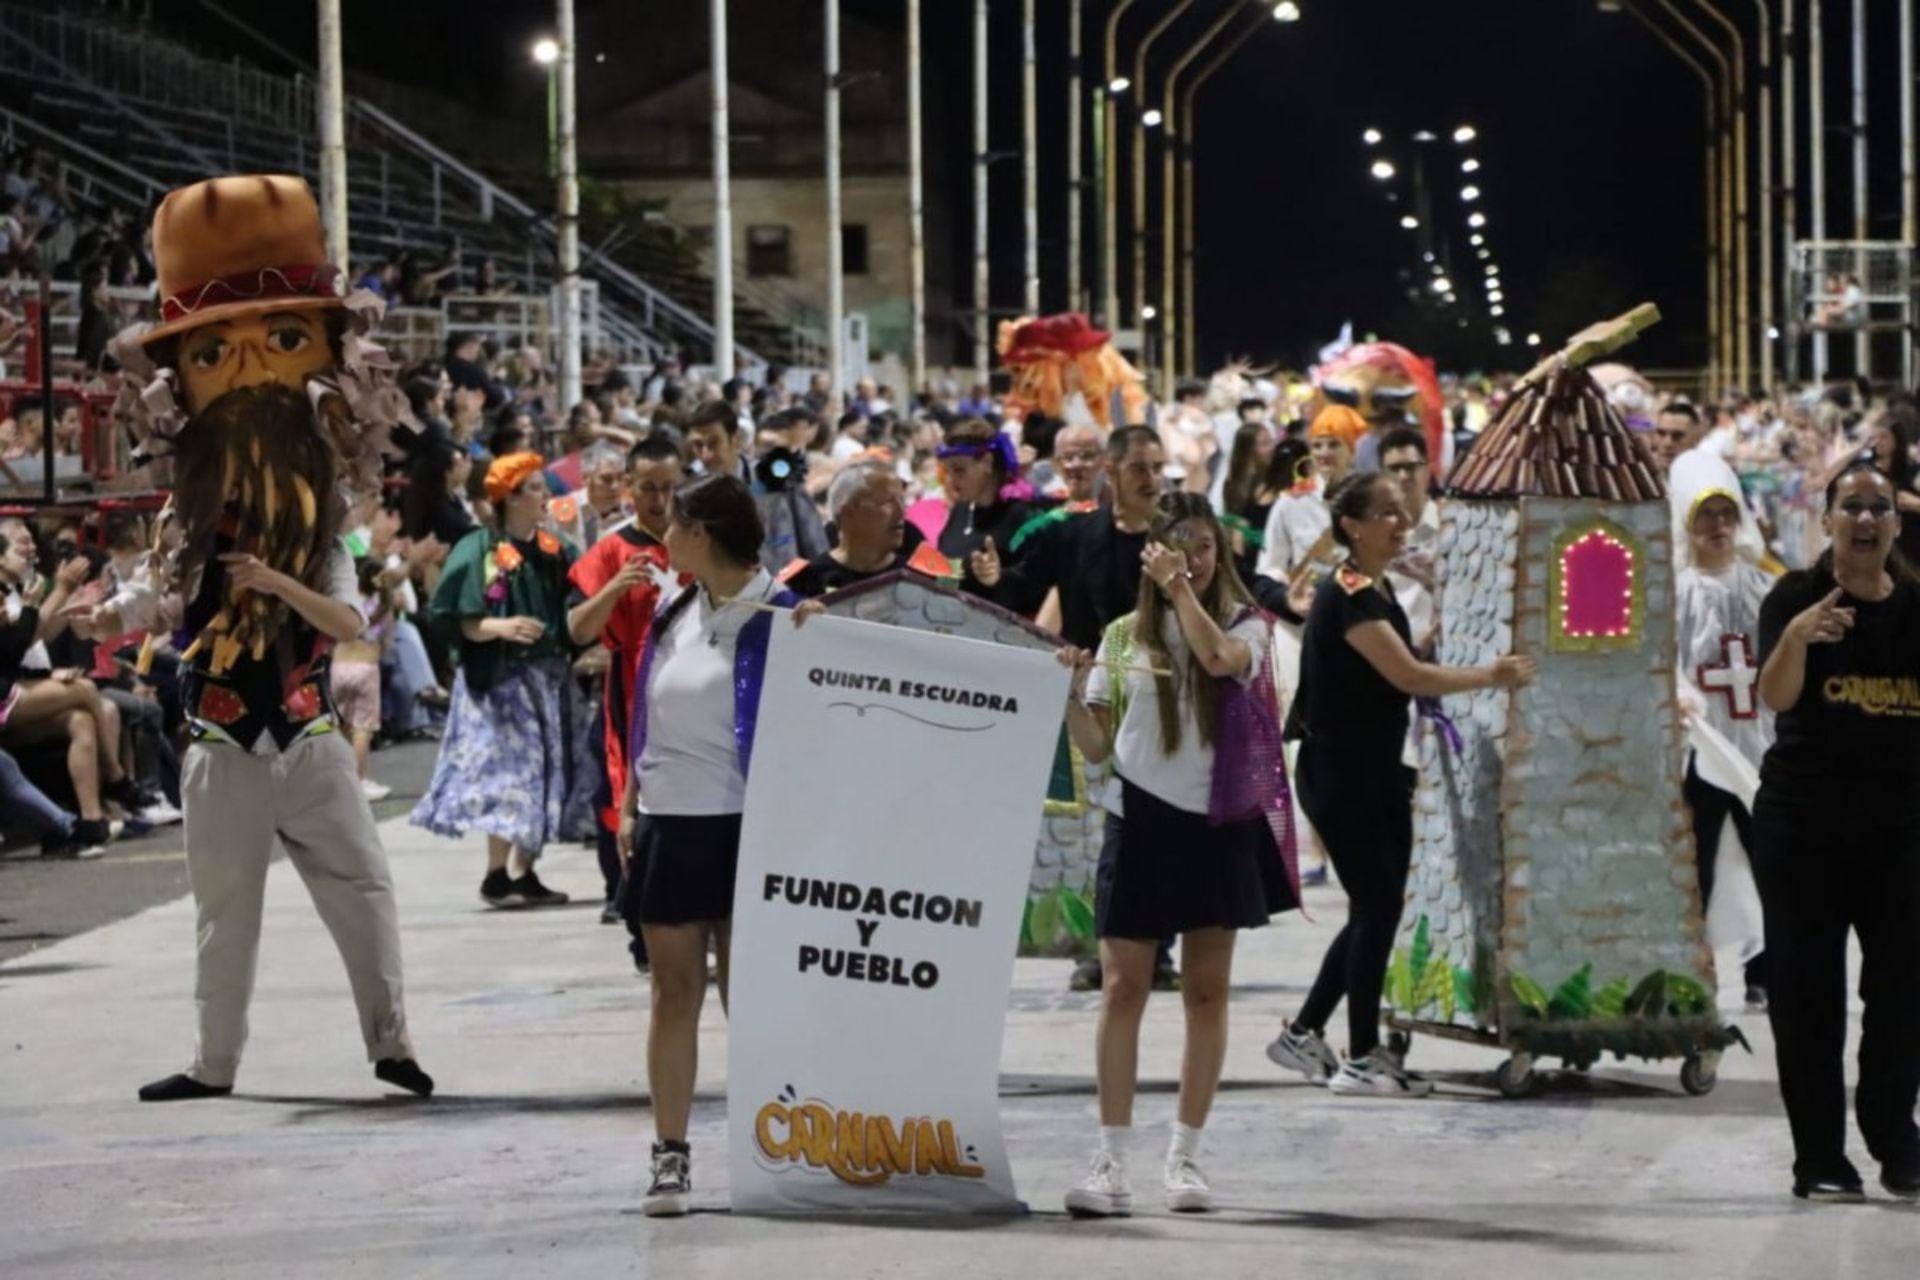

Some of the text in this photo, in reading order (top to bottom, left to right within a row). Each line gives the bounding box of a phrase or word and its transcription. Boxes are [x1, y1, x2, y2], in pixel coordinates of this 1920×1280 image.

[808, 667, 1018, 714] QUINTA ESCUADRA
[763, 873, 983, 928] FUNDACION
[856, 919, 880, 947] Y
[798, 945, 939, 990] PUEBLO
[754, 1101, 985, 1187] CARNAVAL
